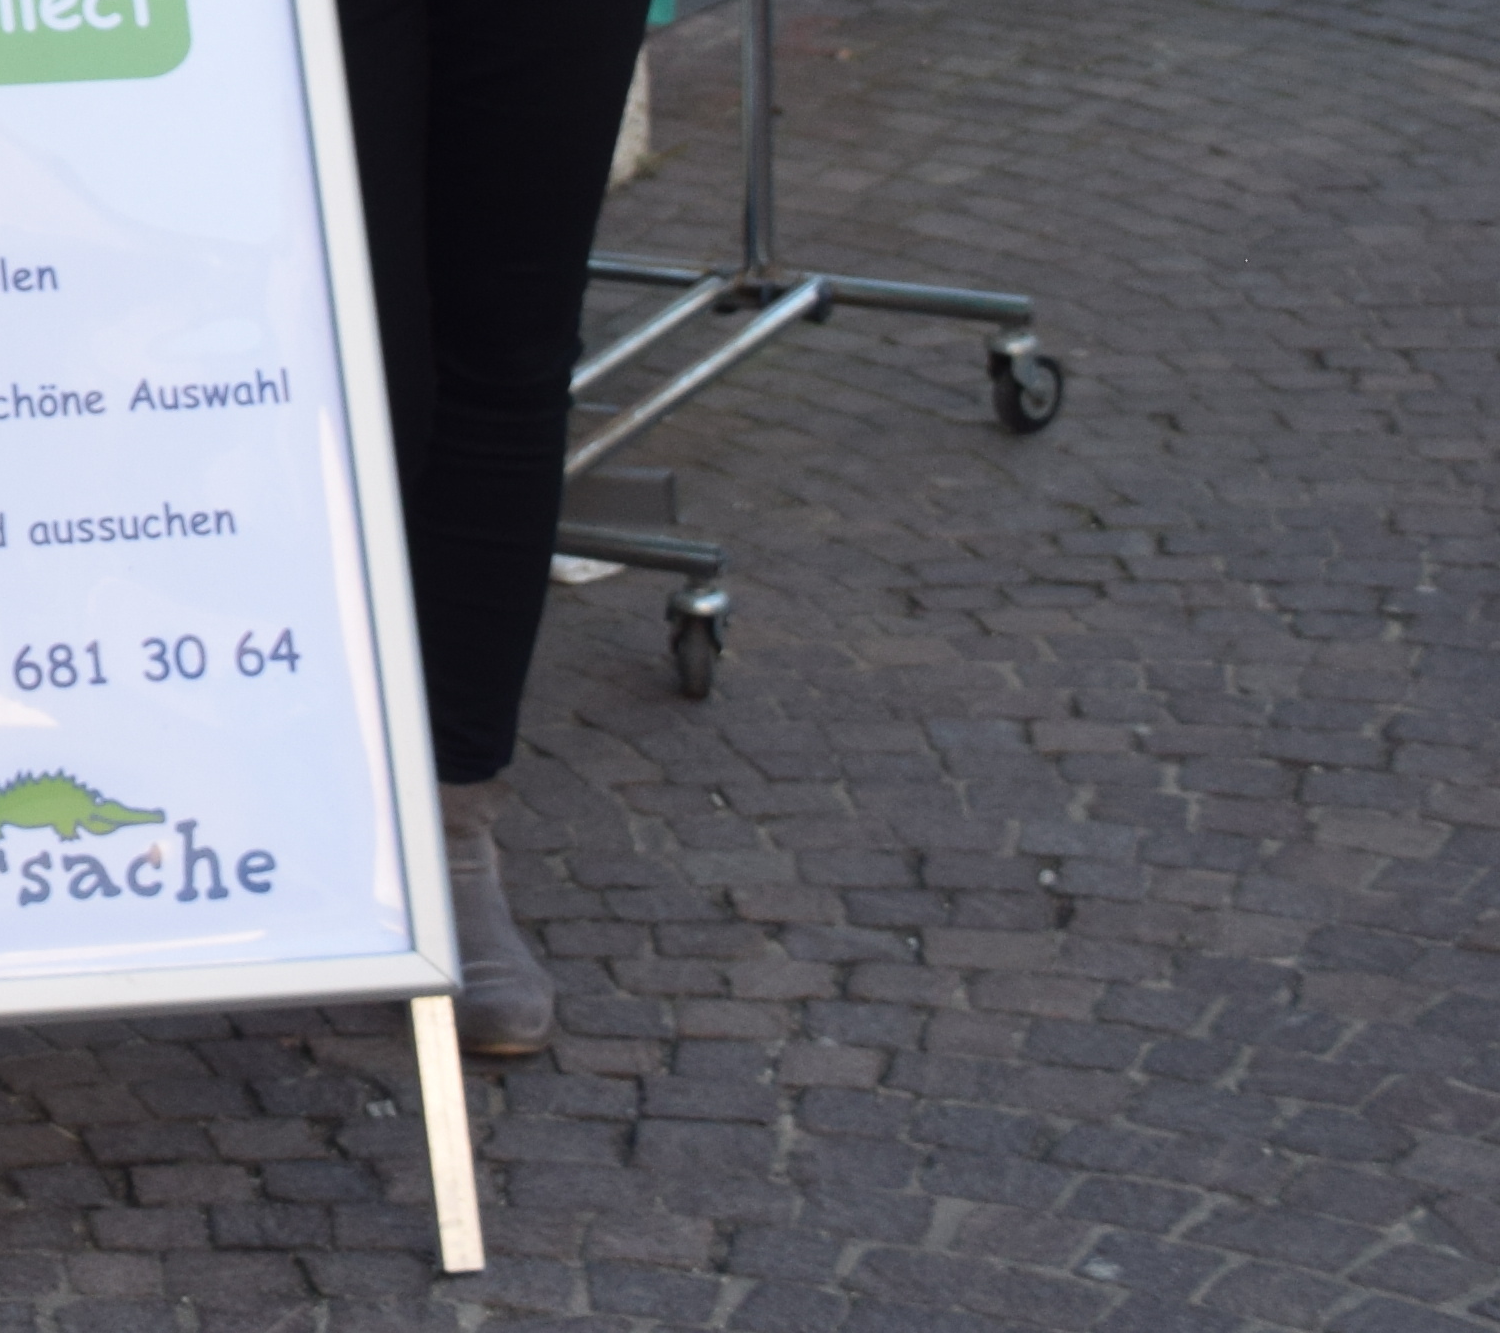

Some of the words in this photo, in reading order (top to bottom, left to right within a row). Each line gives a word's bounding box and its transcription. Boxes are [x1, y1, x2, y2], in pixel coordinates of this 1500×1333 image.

[128, 368, 292, 412] Auswahl
[28, 502, 236, 546] aussuchen
[11, 640, 109, 692] 681
[141, 634, 209, 681] 30
[235, 628, 302, 677] 64
